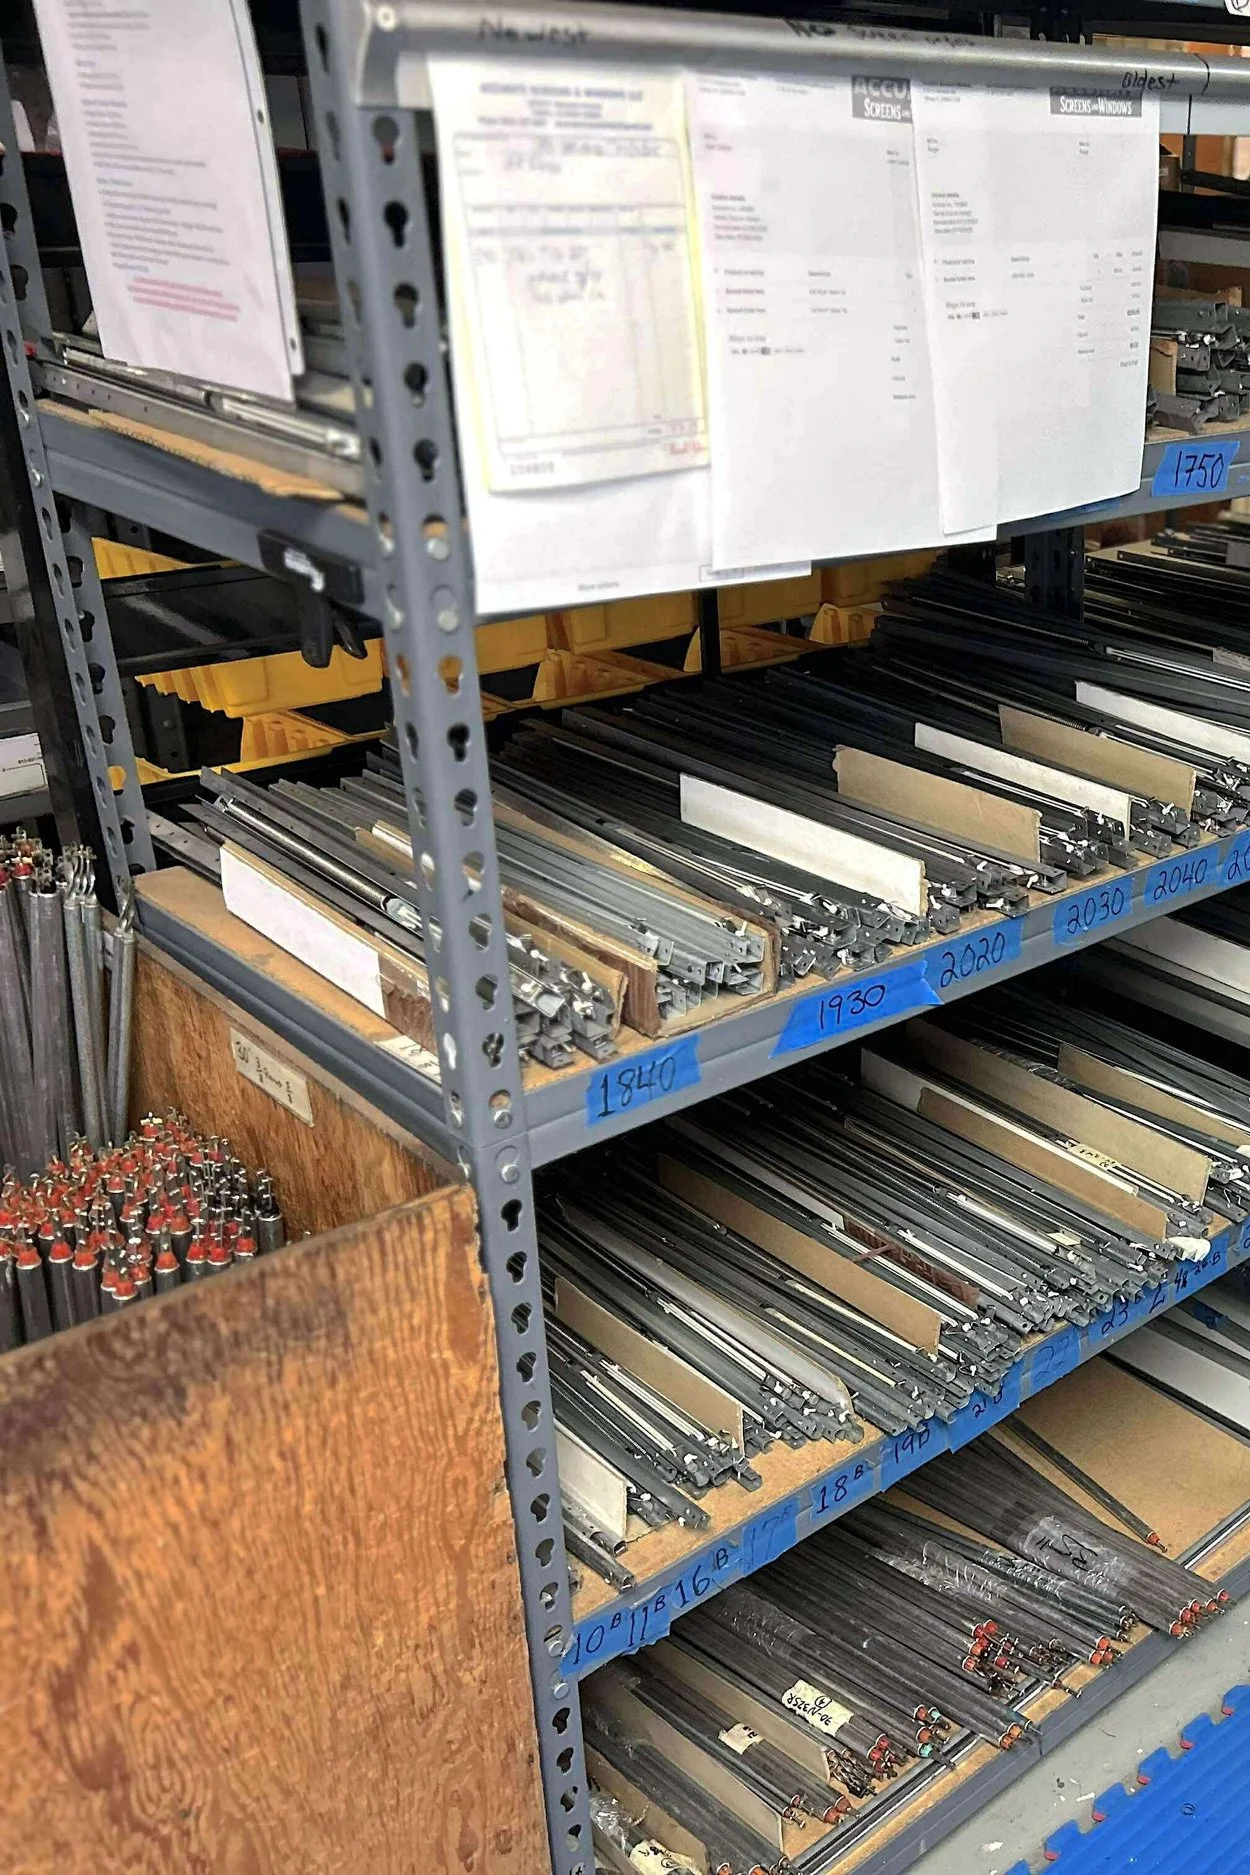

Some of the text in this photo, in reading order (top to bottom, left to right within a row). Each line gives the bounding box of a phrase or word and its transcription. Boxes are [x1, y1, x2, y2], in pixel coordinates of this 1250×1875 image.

[1122, 69, 1180, 89] Oldest
[863, 98, 900, 120] SCREENS
[1060, 95, 1091, 113] SCREENS
[1097, 97, 1132, 115] WINDOWS
[1174, 450, 1224, 489] 1750
[1153, 857, 1207, 897] 2040
[1066, 886, 1126, 934] 2030
[939, 931, 1007, 988] 2020
[818, 983, 886, 1030] 1930
[597, 1055, 677, 1118] 1840
[815, 1464, 865, 1515] 18B
